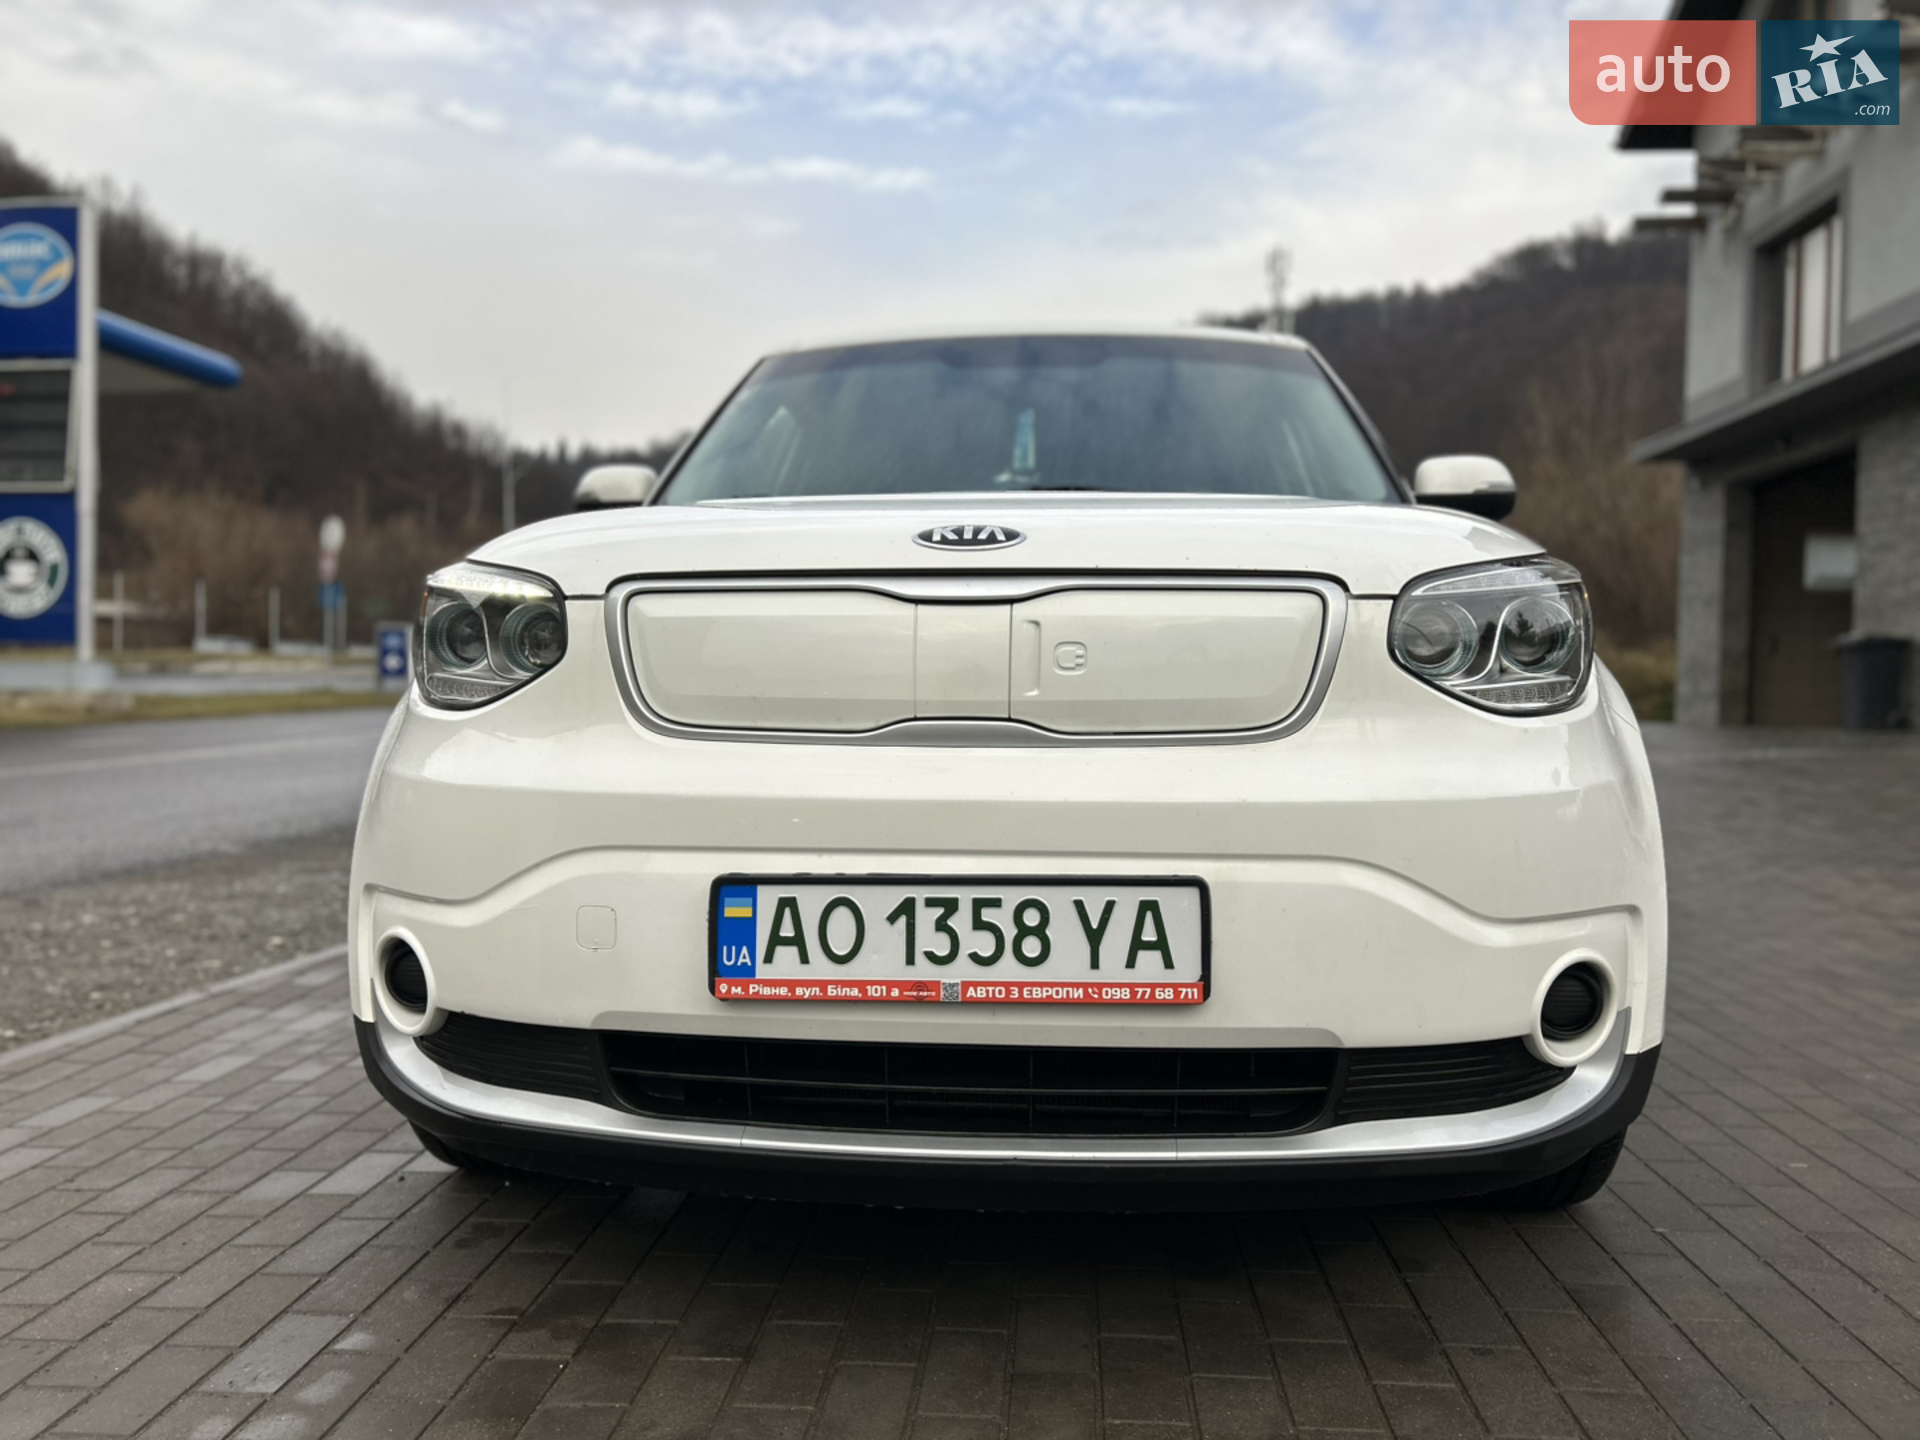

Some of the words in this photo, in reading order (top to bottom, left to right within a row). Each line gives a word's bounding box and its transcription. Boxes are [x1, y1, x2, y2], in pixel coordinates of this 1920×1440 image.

[932, 526, 1006, 542] KIA
[763, 896, 865, 965] AO
[886, 896, 1052, 967] 1358
[1074, 898, 1175, 970] YA
[723, 945, 752, 966] UA
[731, 985, 745, 996] м.
[749, 983, 791, 997] Рівне,
[795, 986, 823, 998] вул.
[827, 984, 862, 998] Біла,
[866, 985, 886, 997] 101
[966, 986, 1006, 998] АВТО
[1023, 987, 1084, 999] ЄВРОПИ
[1102, 987, 1130, 1000] 098
[1134, 987, 1152, 1000] 77
[1155, 987, 1174, 1000] 68
[1178, 987, 1198, 1000] 711
